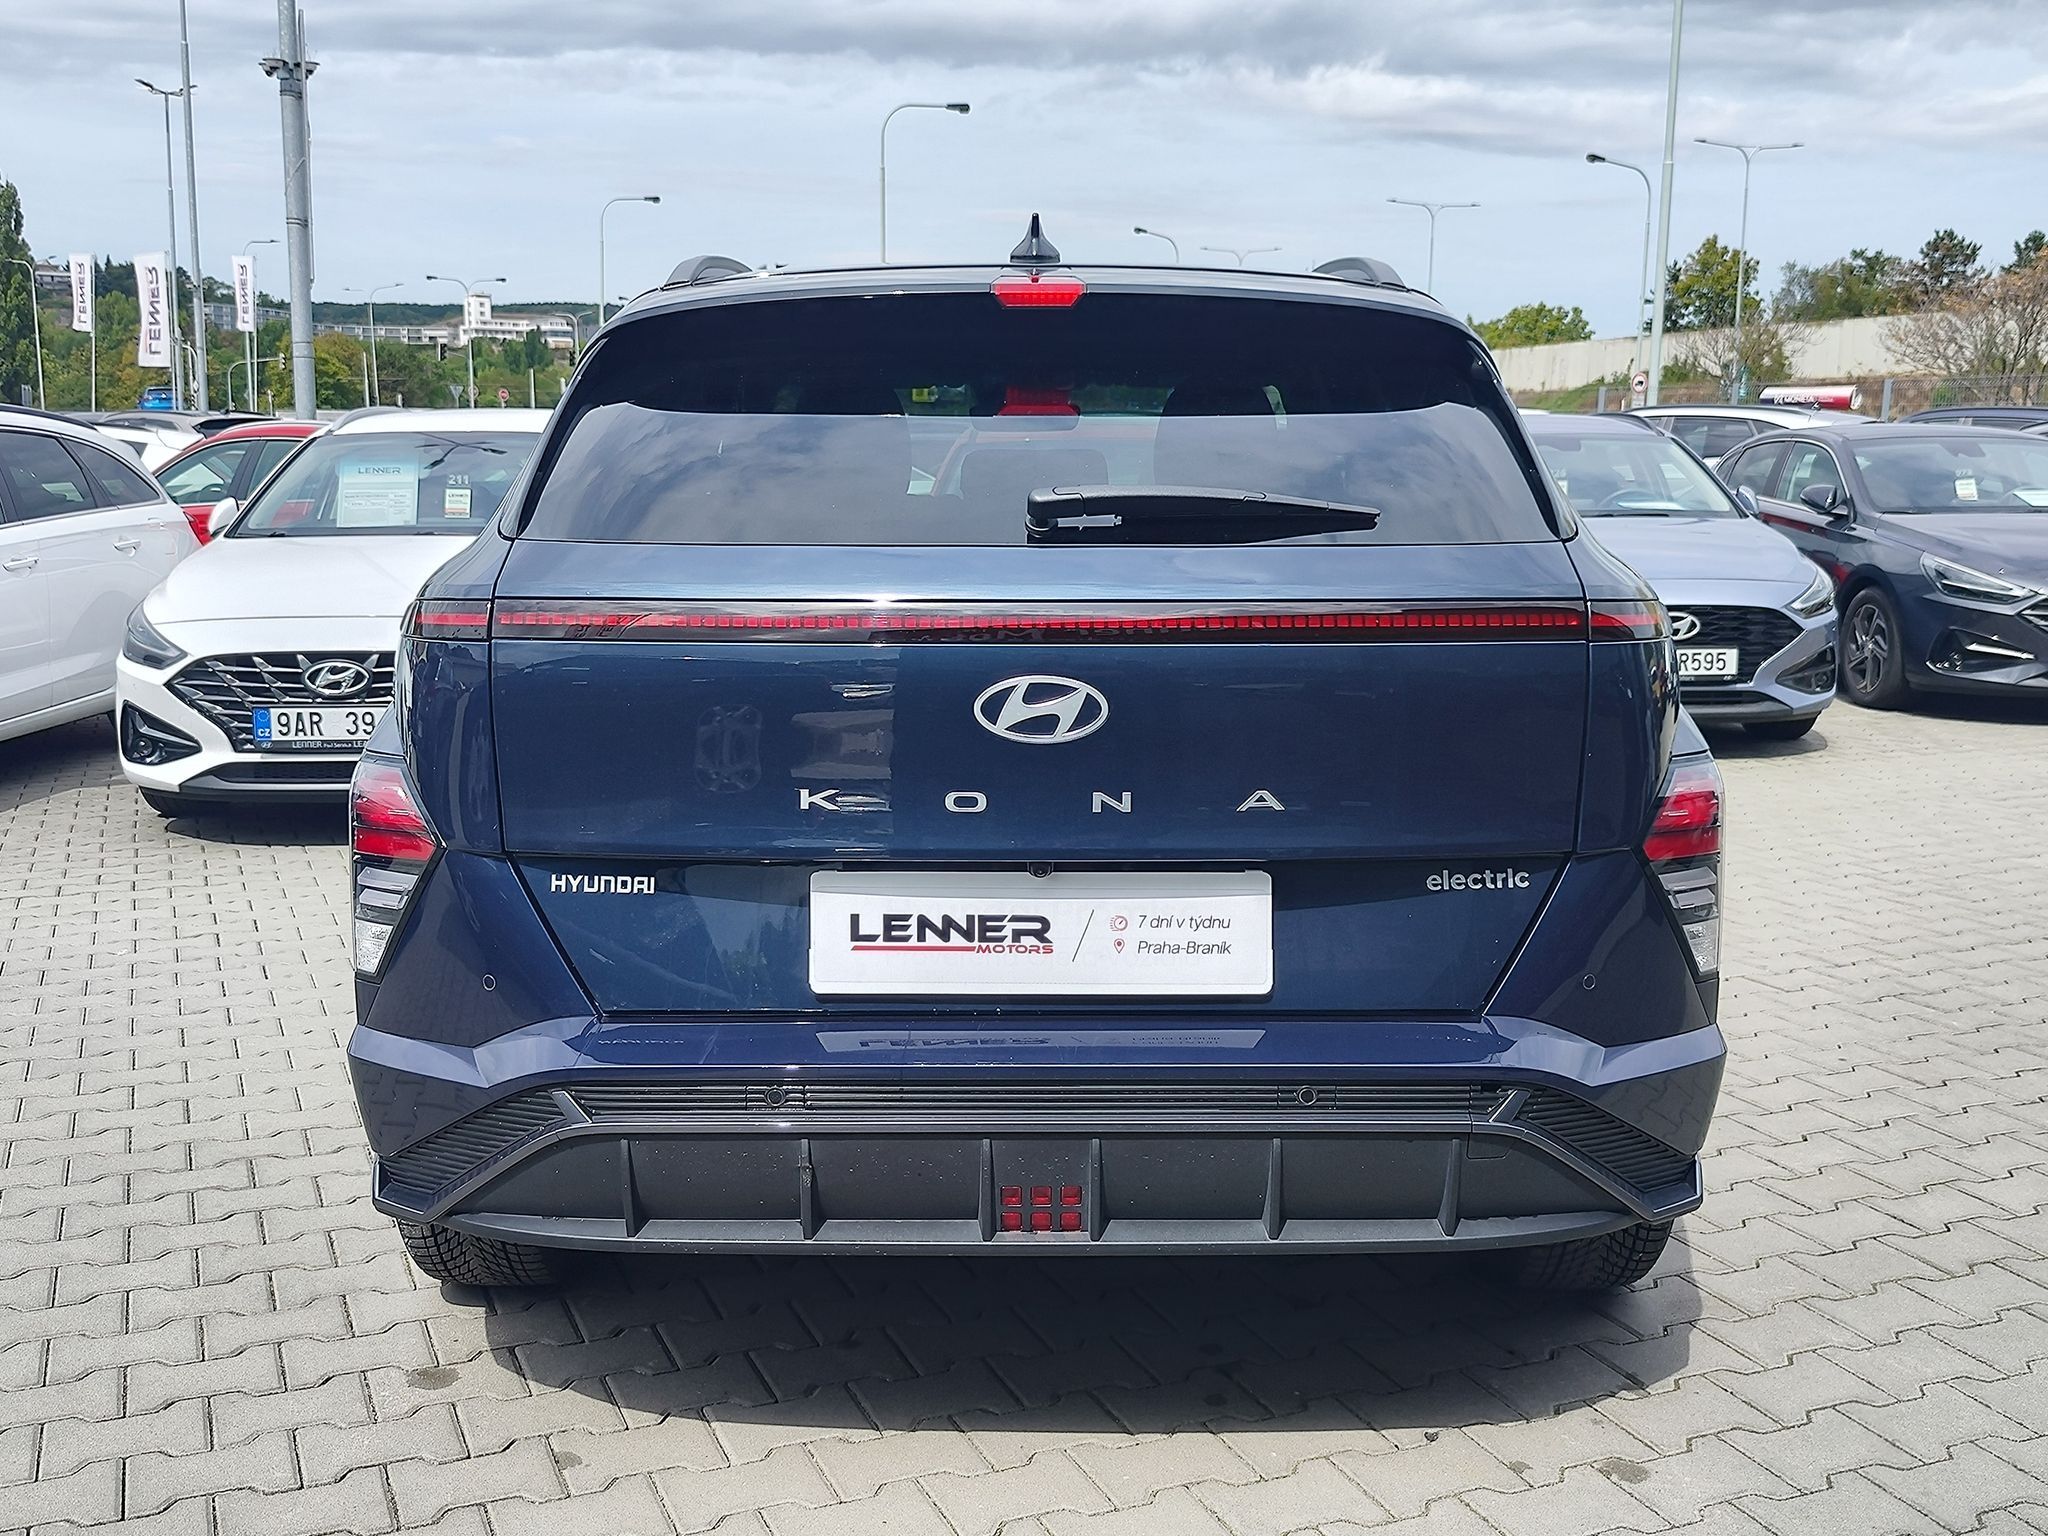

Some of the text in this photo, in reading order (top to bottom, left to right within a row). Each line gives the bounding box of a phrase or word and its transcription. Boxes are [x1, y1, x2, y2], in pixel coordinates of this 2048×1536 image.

[448, 474, 469, 485] 211
[258, 729, 271, 737] CZ
[277, 712, 324, 737] 9AR
[798, 789, 1286, 812] KONA
[550, 873, 655, 895] HYUNDAI
[1426, 868, 1530, 891] electric
[850, 913, 1054, 943] LENNER
[1137, 914, 1231, 932] 7 dní v týdnu
[976, 944, 1054, 954] MOTORS
[1137, 940, 1232, 955] Praha-Braník
